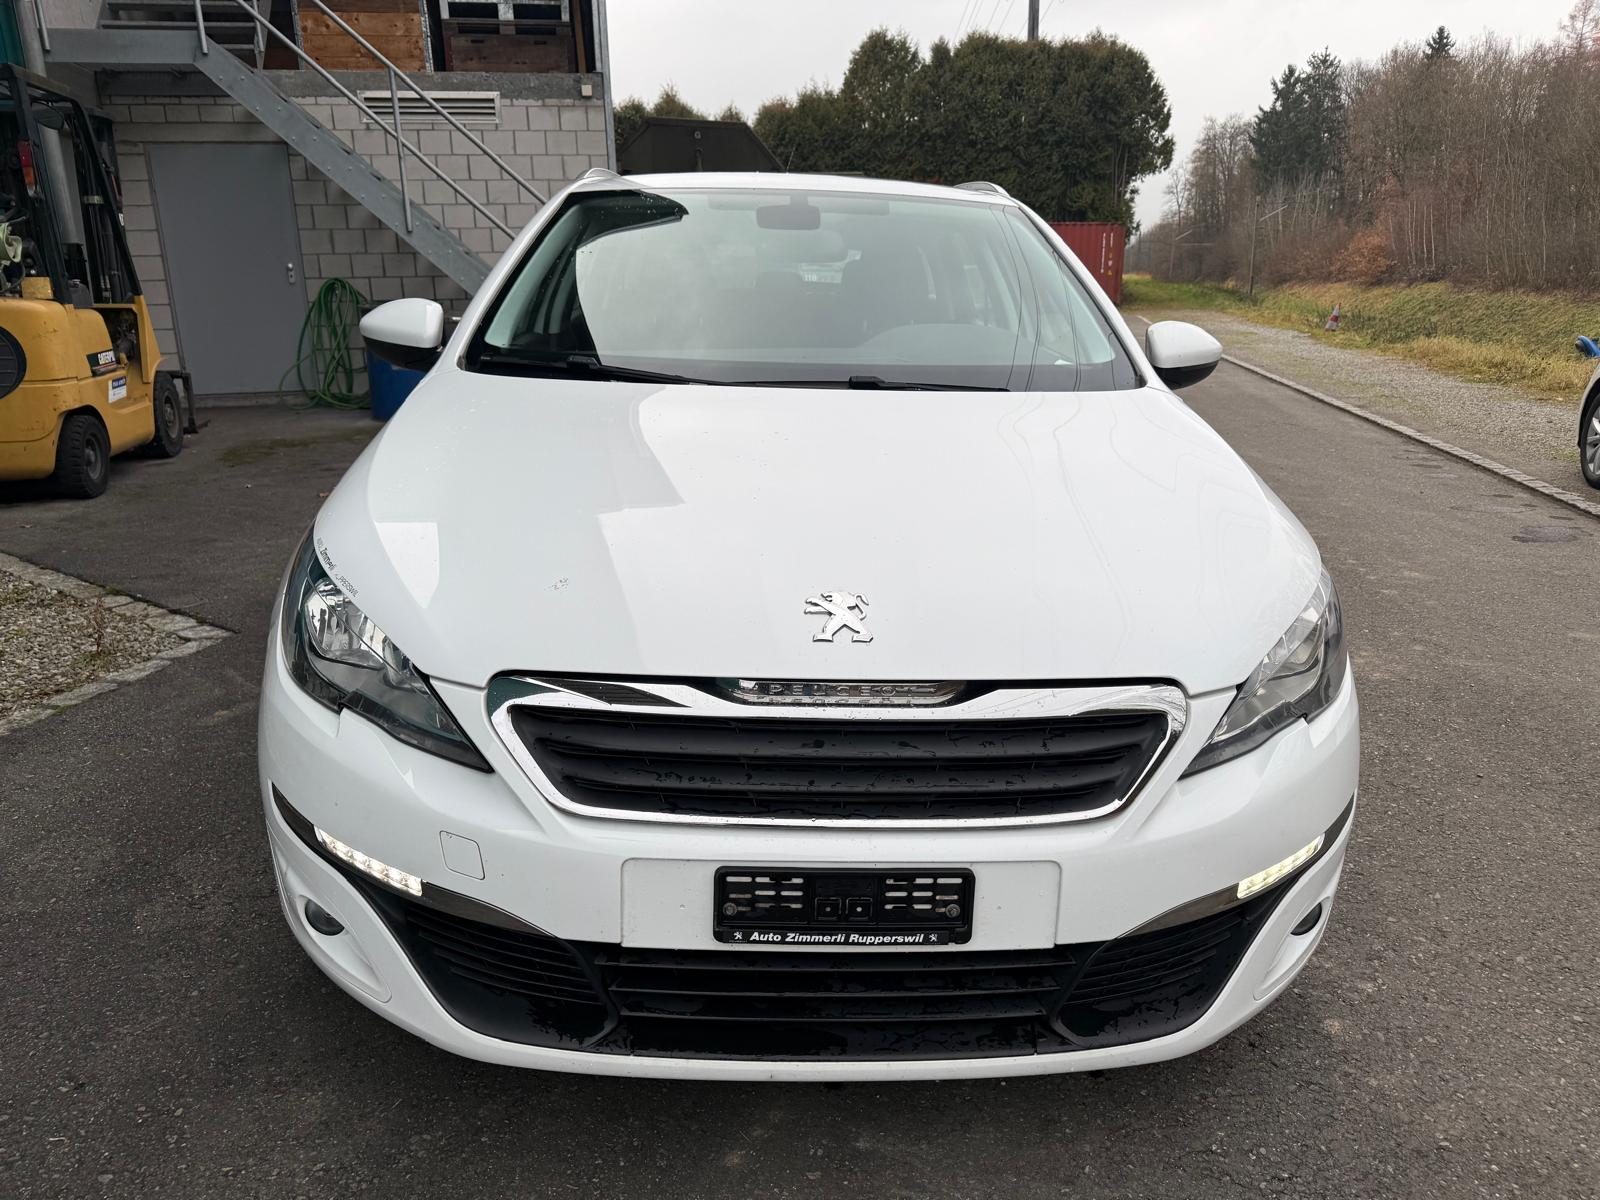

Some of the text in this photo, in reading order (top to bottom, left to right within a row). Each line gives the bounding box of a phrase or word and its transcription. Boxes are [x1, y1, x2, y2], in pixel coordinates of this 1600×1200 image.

[749, 931, 925, 945] Auto Zimmerli Rupperswil
